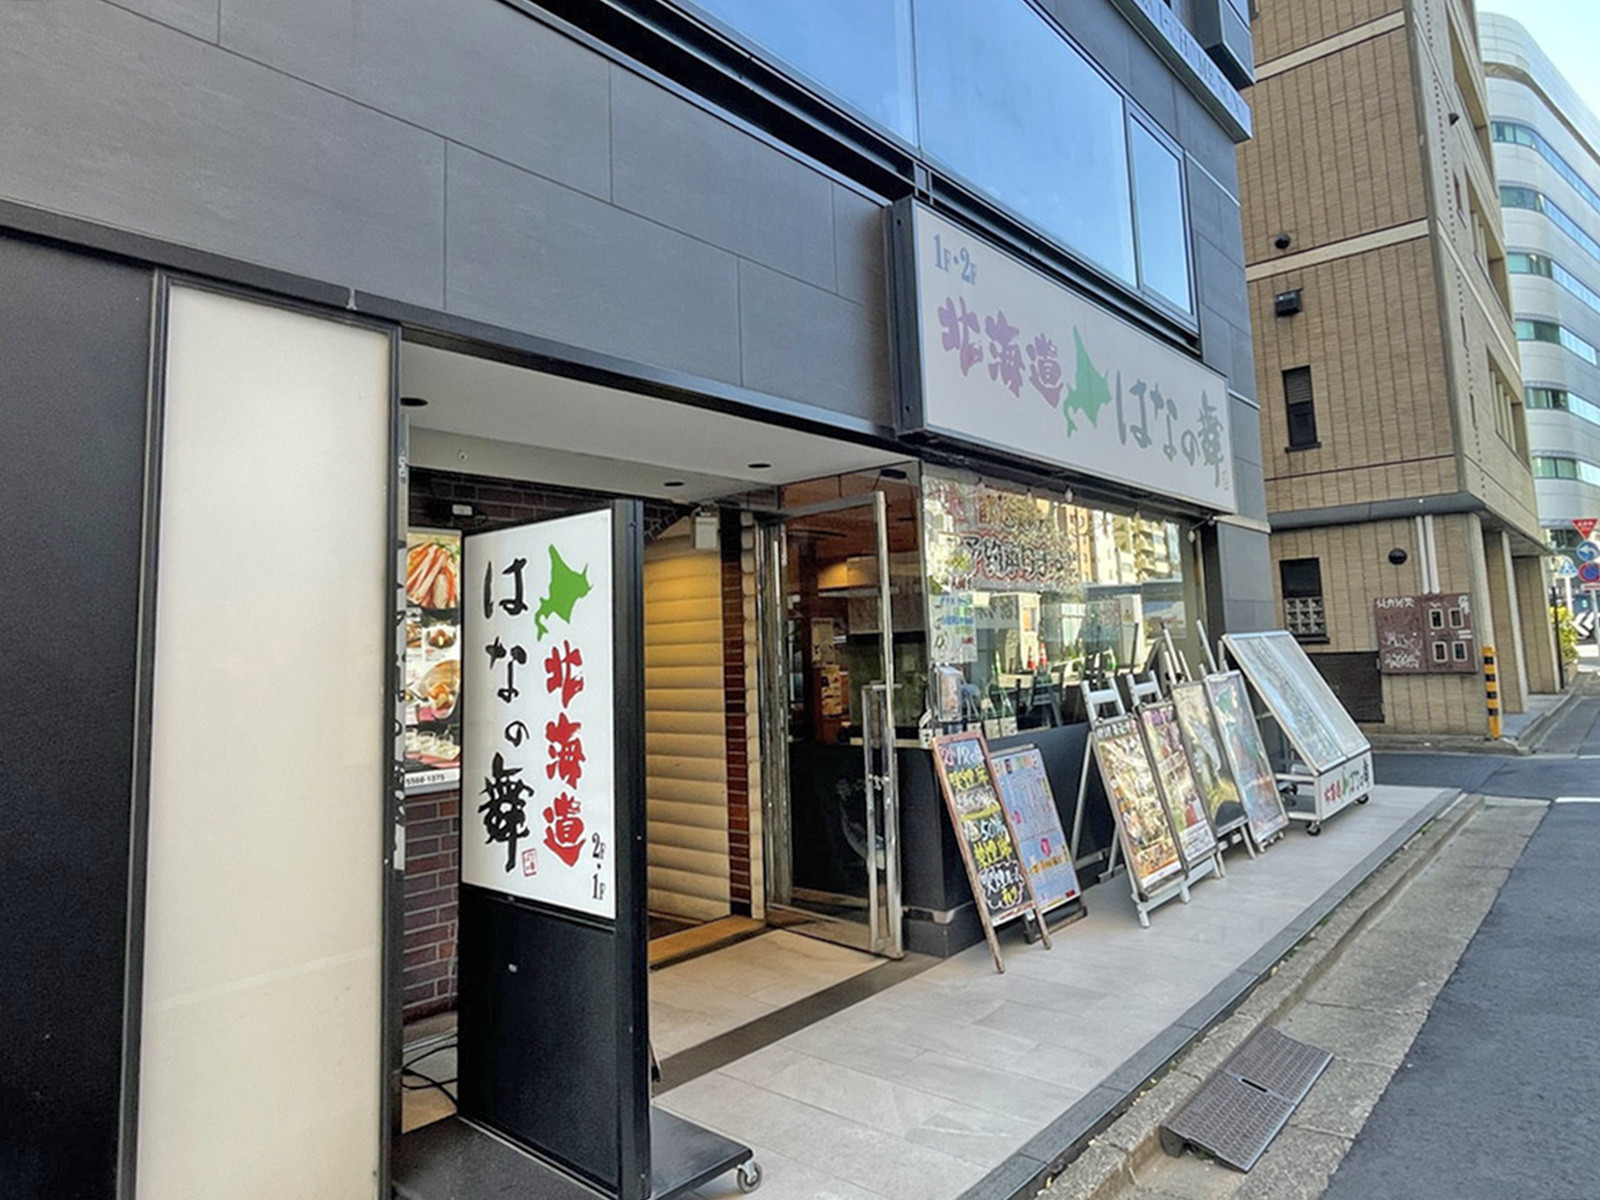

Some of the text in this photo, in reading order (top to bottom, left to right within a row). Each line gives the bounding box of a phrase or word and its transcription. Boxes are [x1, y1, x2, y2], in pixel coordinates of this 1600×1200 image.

[937, 296, 1224, 488] 北海道 はなの舞
[477, 556, 534, 873] はなの舞
[541, 640, 586, 867] 北海道
